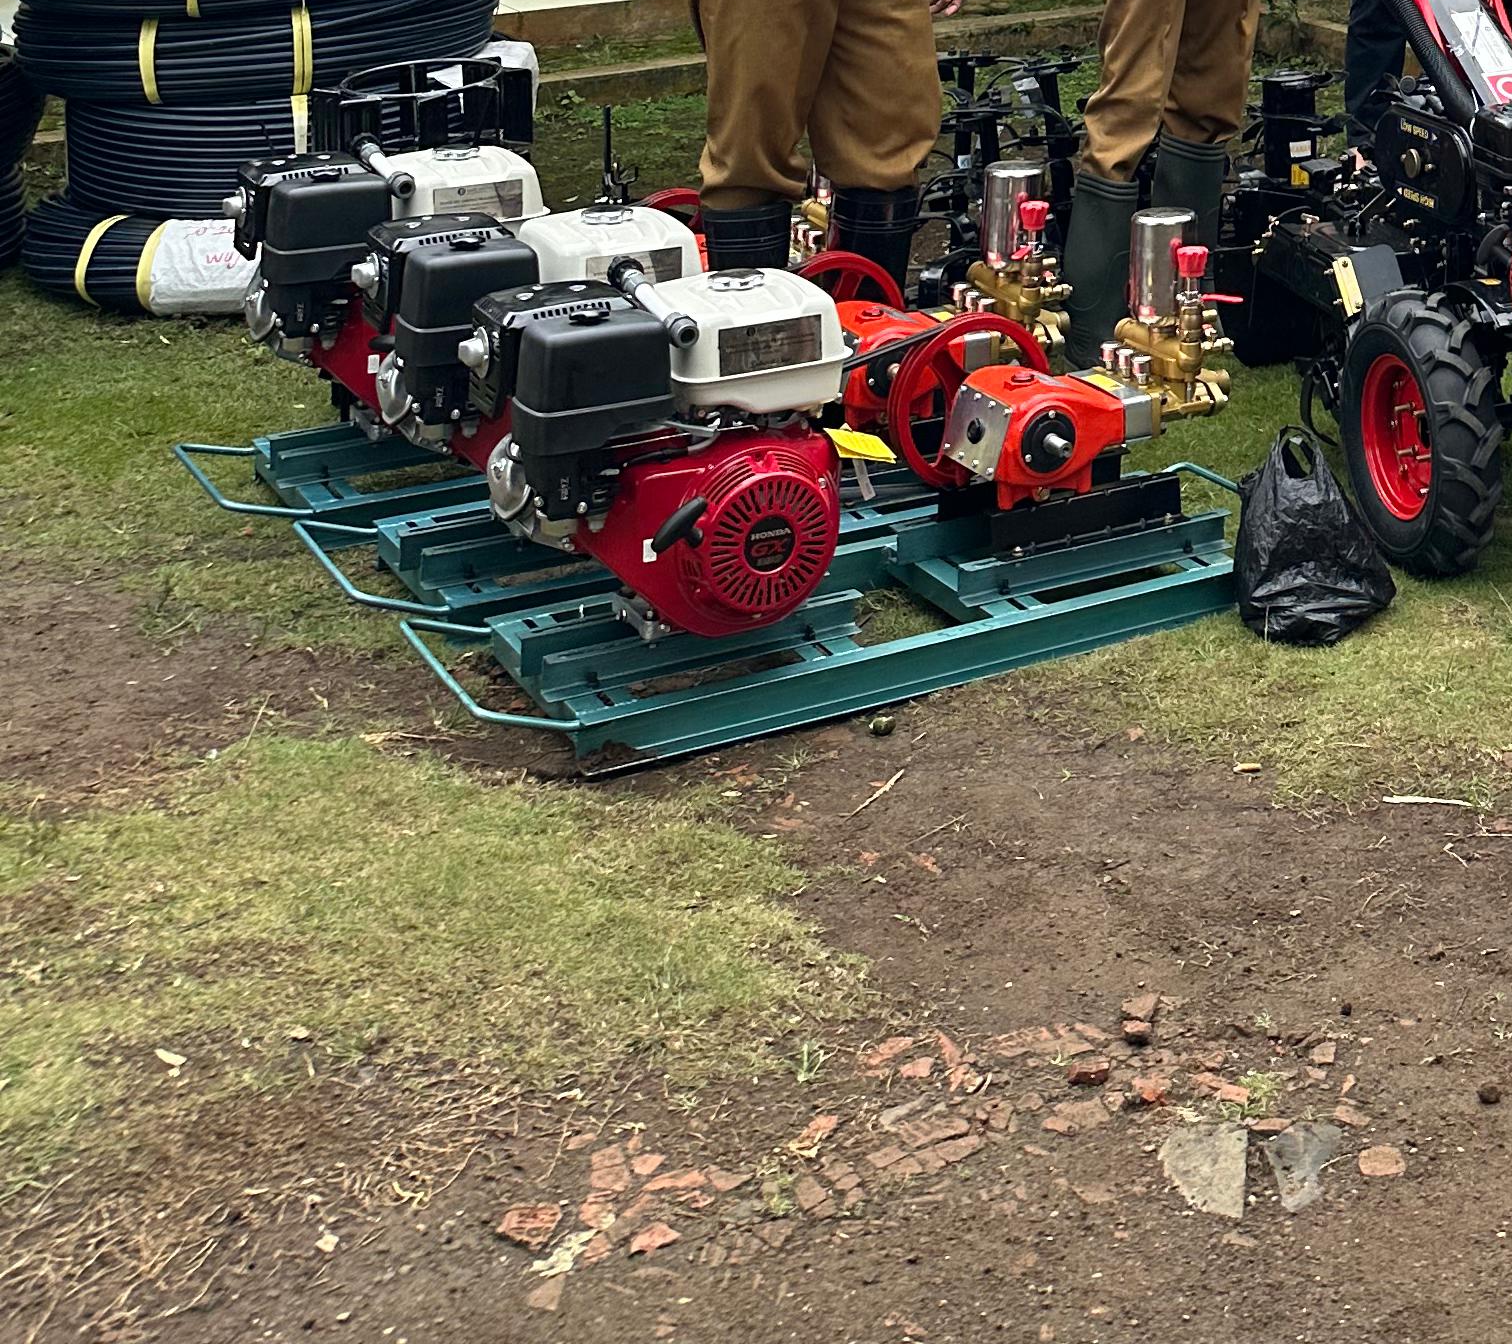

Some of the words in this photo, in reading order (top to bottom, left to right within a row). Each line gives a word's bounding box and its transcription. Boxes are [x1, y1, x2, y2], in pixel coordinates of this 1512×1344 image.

[1400, 117, 1413, 134] LOW
[1412, 124, 1430, 141] SPEED
[750, 527, 792, 541] HONDA
